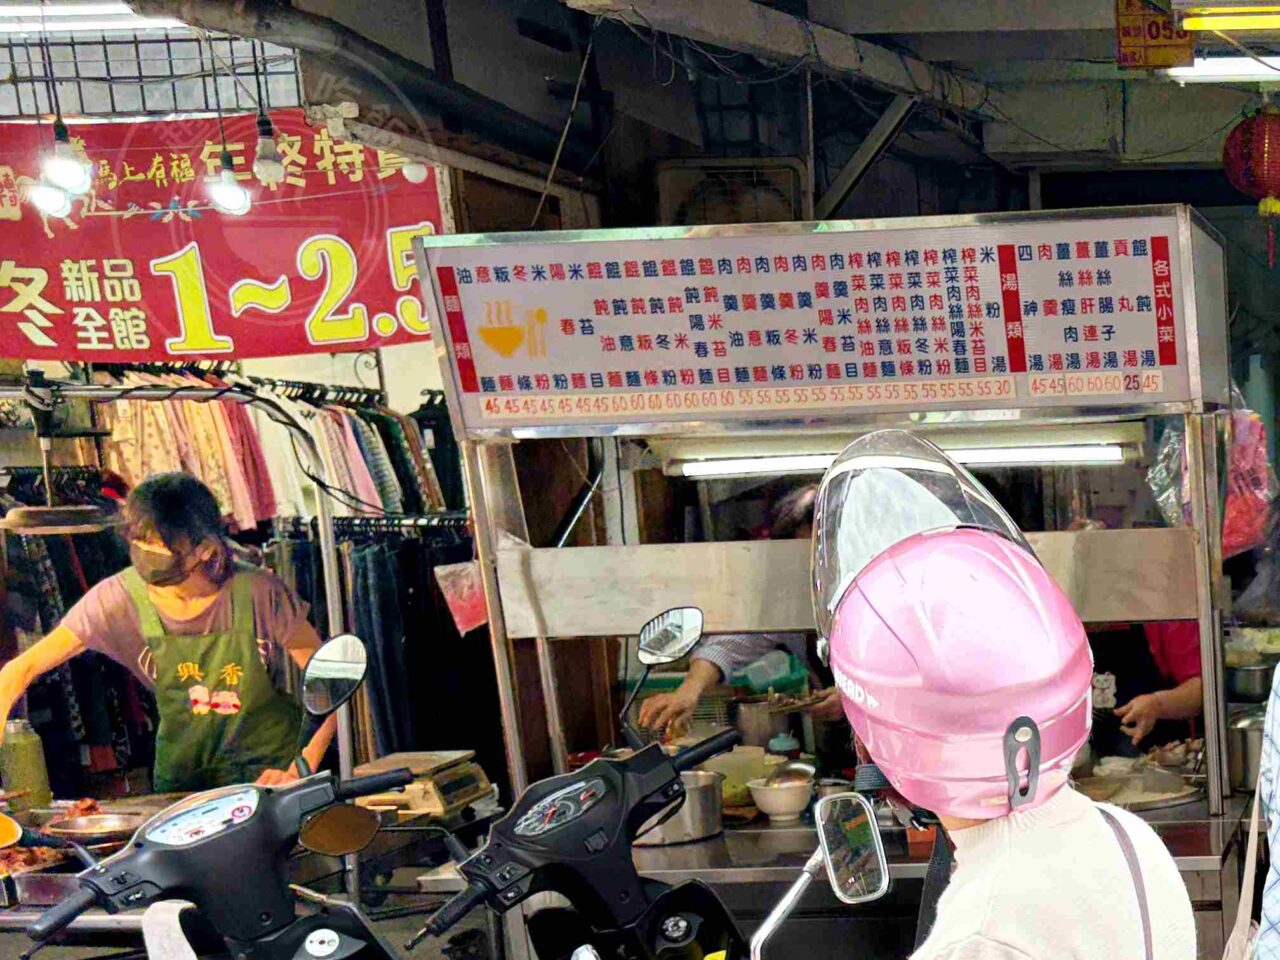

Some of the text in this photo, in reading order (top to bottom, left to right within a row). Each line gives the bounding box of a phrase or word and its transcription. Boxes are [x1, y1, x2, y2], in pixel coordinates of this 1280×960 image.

[97, 151, 197, 191] 馬上有福
[60, 258, 142, 303] 新品
[1153, 259, 1175, 343] 各式小菜
[443, 295, 472, 361] 麵類
[1001, 273, 1024, 339] 湯類
[71, 307, 152, 351] 全館
[1031, 374, 1158, 394] 45 45 60 60 60 25 45
